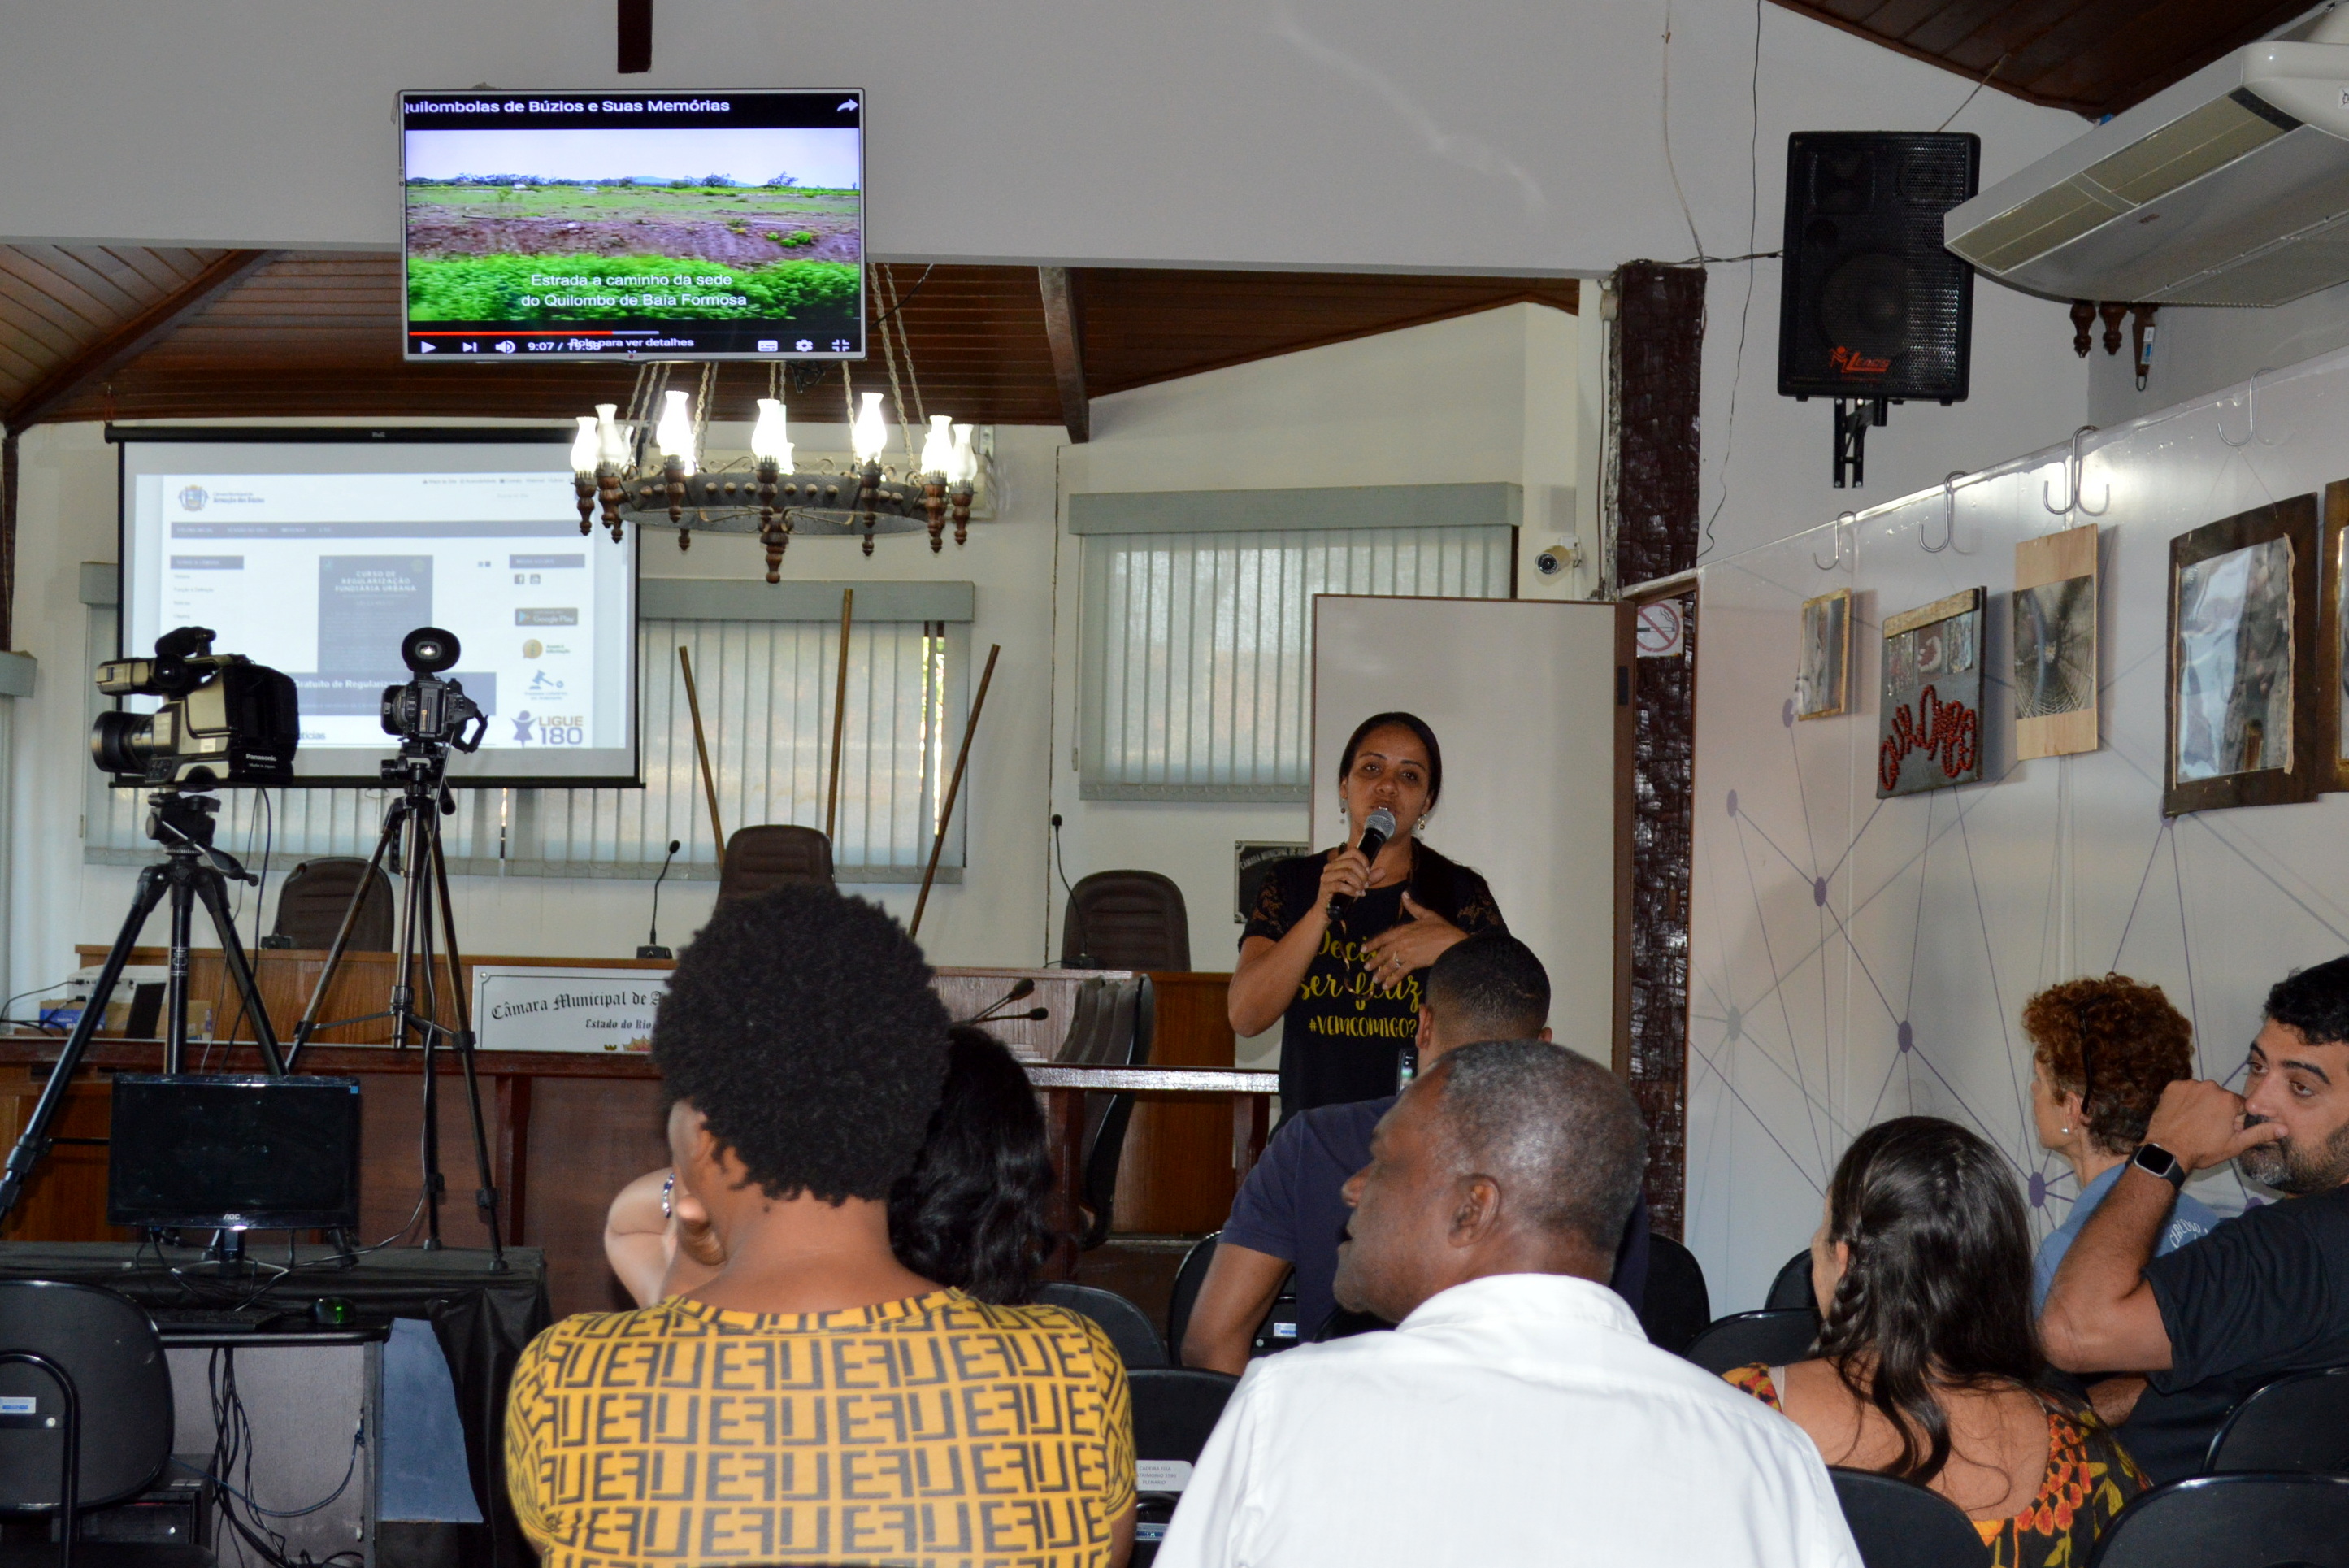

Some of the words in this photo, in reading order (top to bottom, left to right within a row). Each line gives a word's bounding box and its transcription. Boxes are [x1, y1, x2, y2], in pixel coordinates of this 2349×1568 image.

[504, 100, 525, 112] de
[528, 99, 584, 112] Búzios
[588, 103, 598, 112] e
[601, 100, 644, 112] Suas
[647, 99, 731, 112] Memórias
[531, 275, 588, 286] Estrada
[593, 277, 602, 286] a
[606, 274, 670, 286] caminho
[672, 274, 693, 285] da
[696, 274, 733, 285] sede
[521, 295, 541, 306] do
[544, 295, 616, 307] Quilombo
[619, 294, 639, 306] de
[680, 294, 747, 306] Formosa
[527, 341, 555, 352] 9:07
[598, 340, 623, 349] para
[644, 337, 695, 347] detalhes
[538, 715, 584, 727] LIGUE
[541, 727, 584, 745] 180
[245, 753, 277, 762] Panasonic
[491, 997, 548, 1020] Câmara
[553, 991, 627, 1011] Municipal
[632, 991, 647, 1006] de
[585, 1019, 619, 1029] Estado
[620, 1019, 633, 1029] do
[636, 1019, 652, 1030] Rio
[1309, 1014, 1417, 1039] #VEMCOMIGO?
